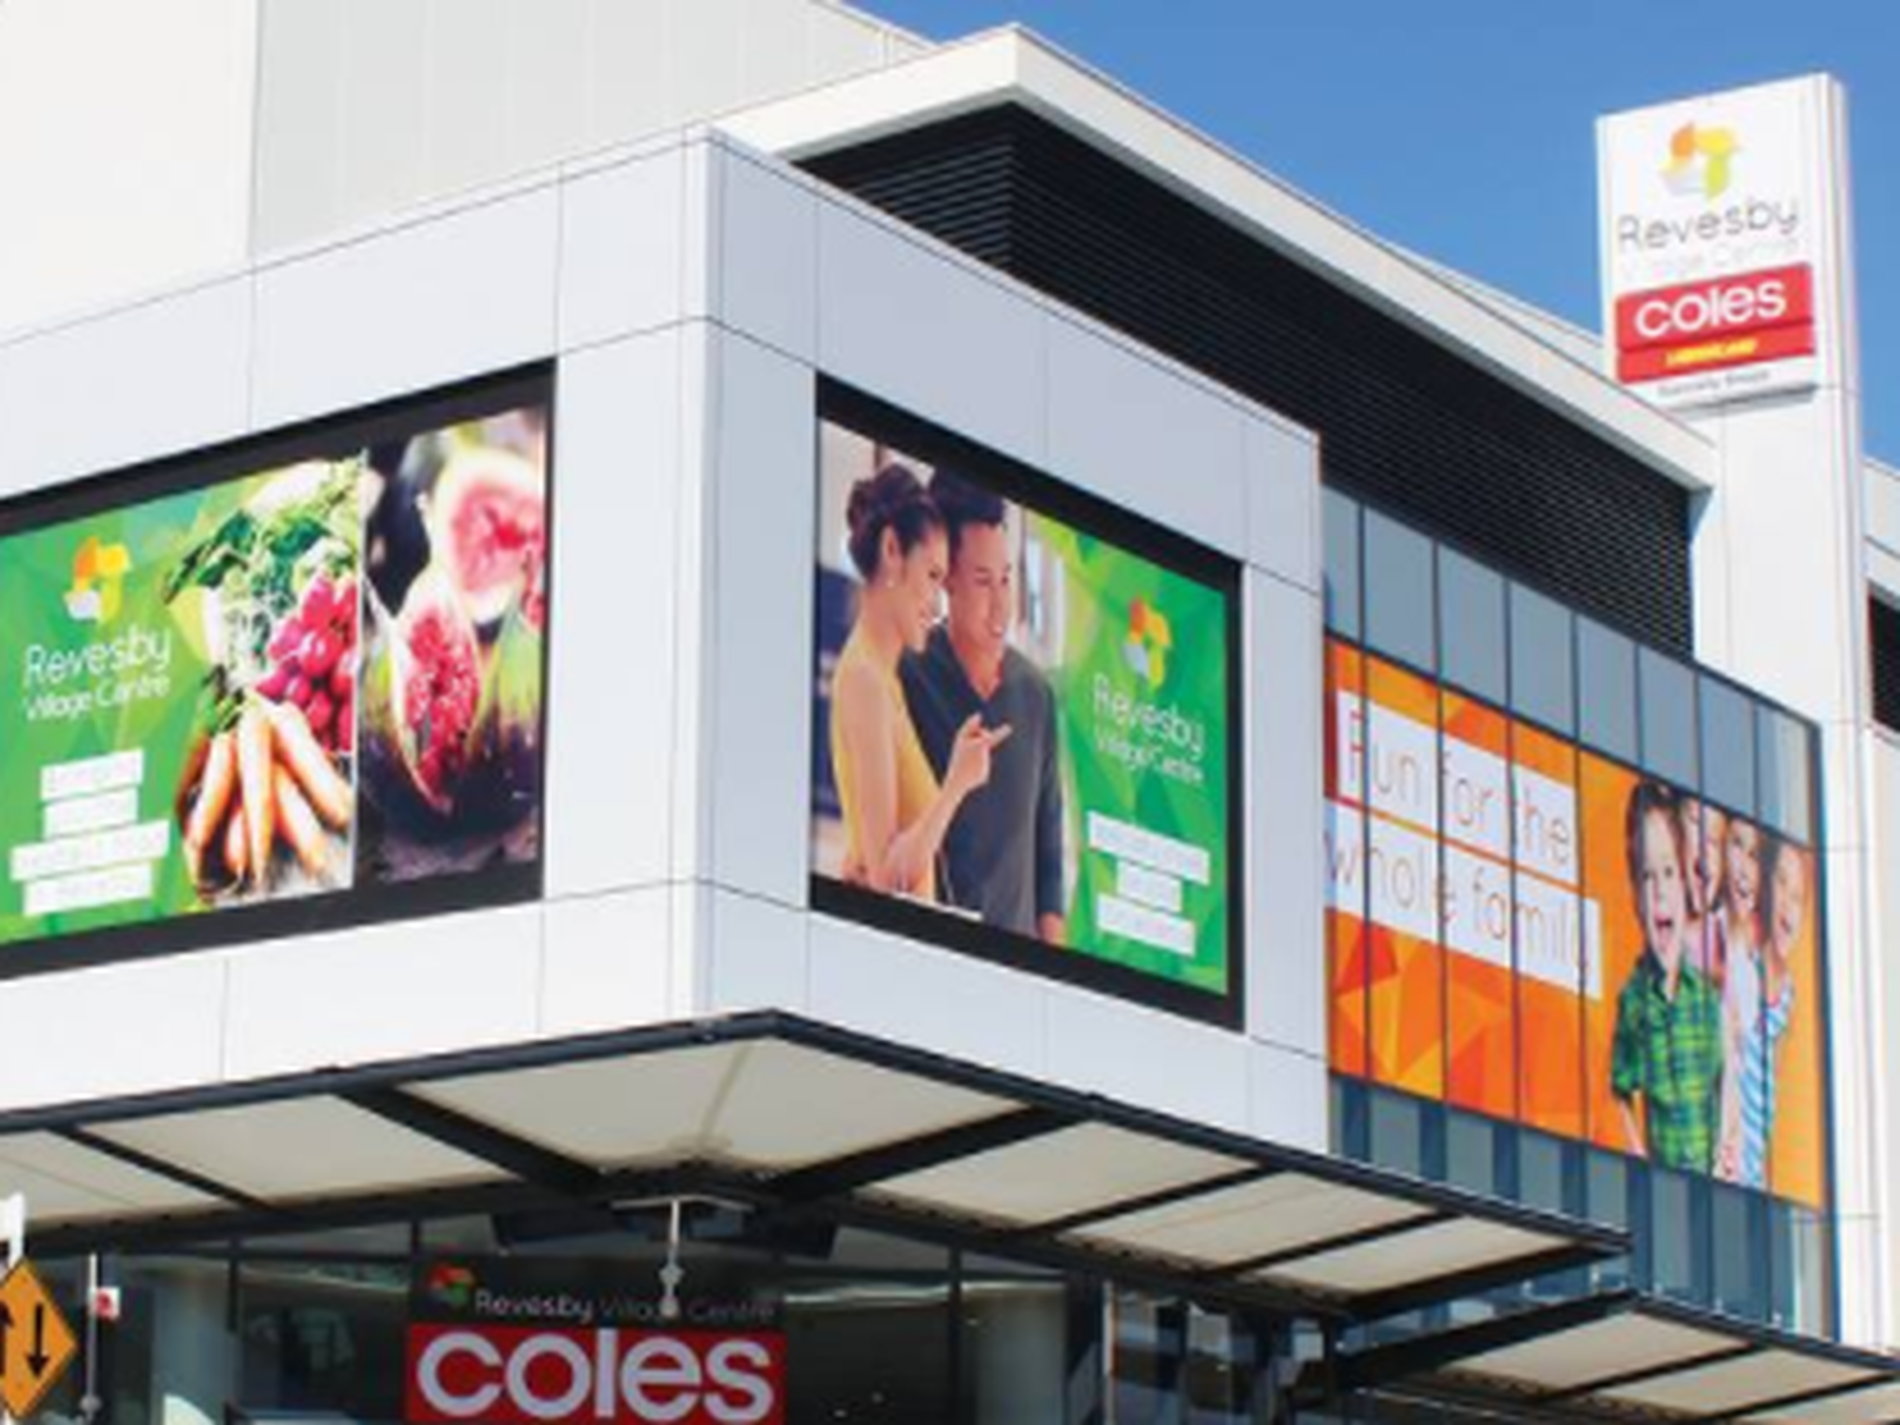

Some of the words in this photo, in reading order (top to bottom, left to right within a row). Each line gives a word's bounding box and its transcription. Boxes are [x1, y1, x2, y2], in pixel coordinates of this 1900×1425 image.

[1617, 197, 1799, 248] Revesby
[1634, 280, 1788, 338] coles
[24, 624, 171, 688] Revesby
[1094, 671, 1205, 761] Revesby
[1513, 782, 1570, 866] he
[474, 1290, 592, 1322] Revesby
[417, 1328, 774, 1423] coles
